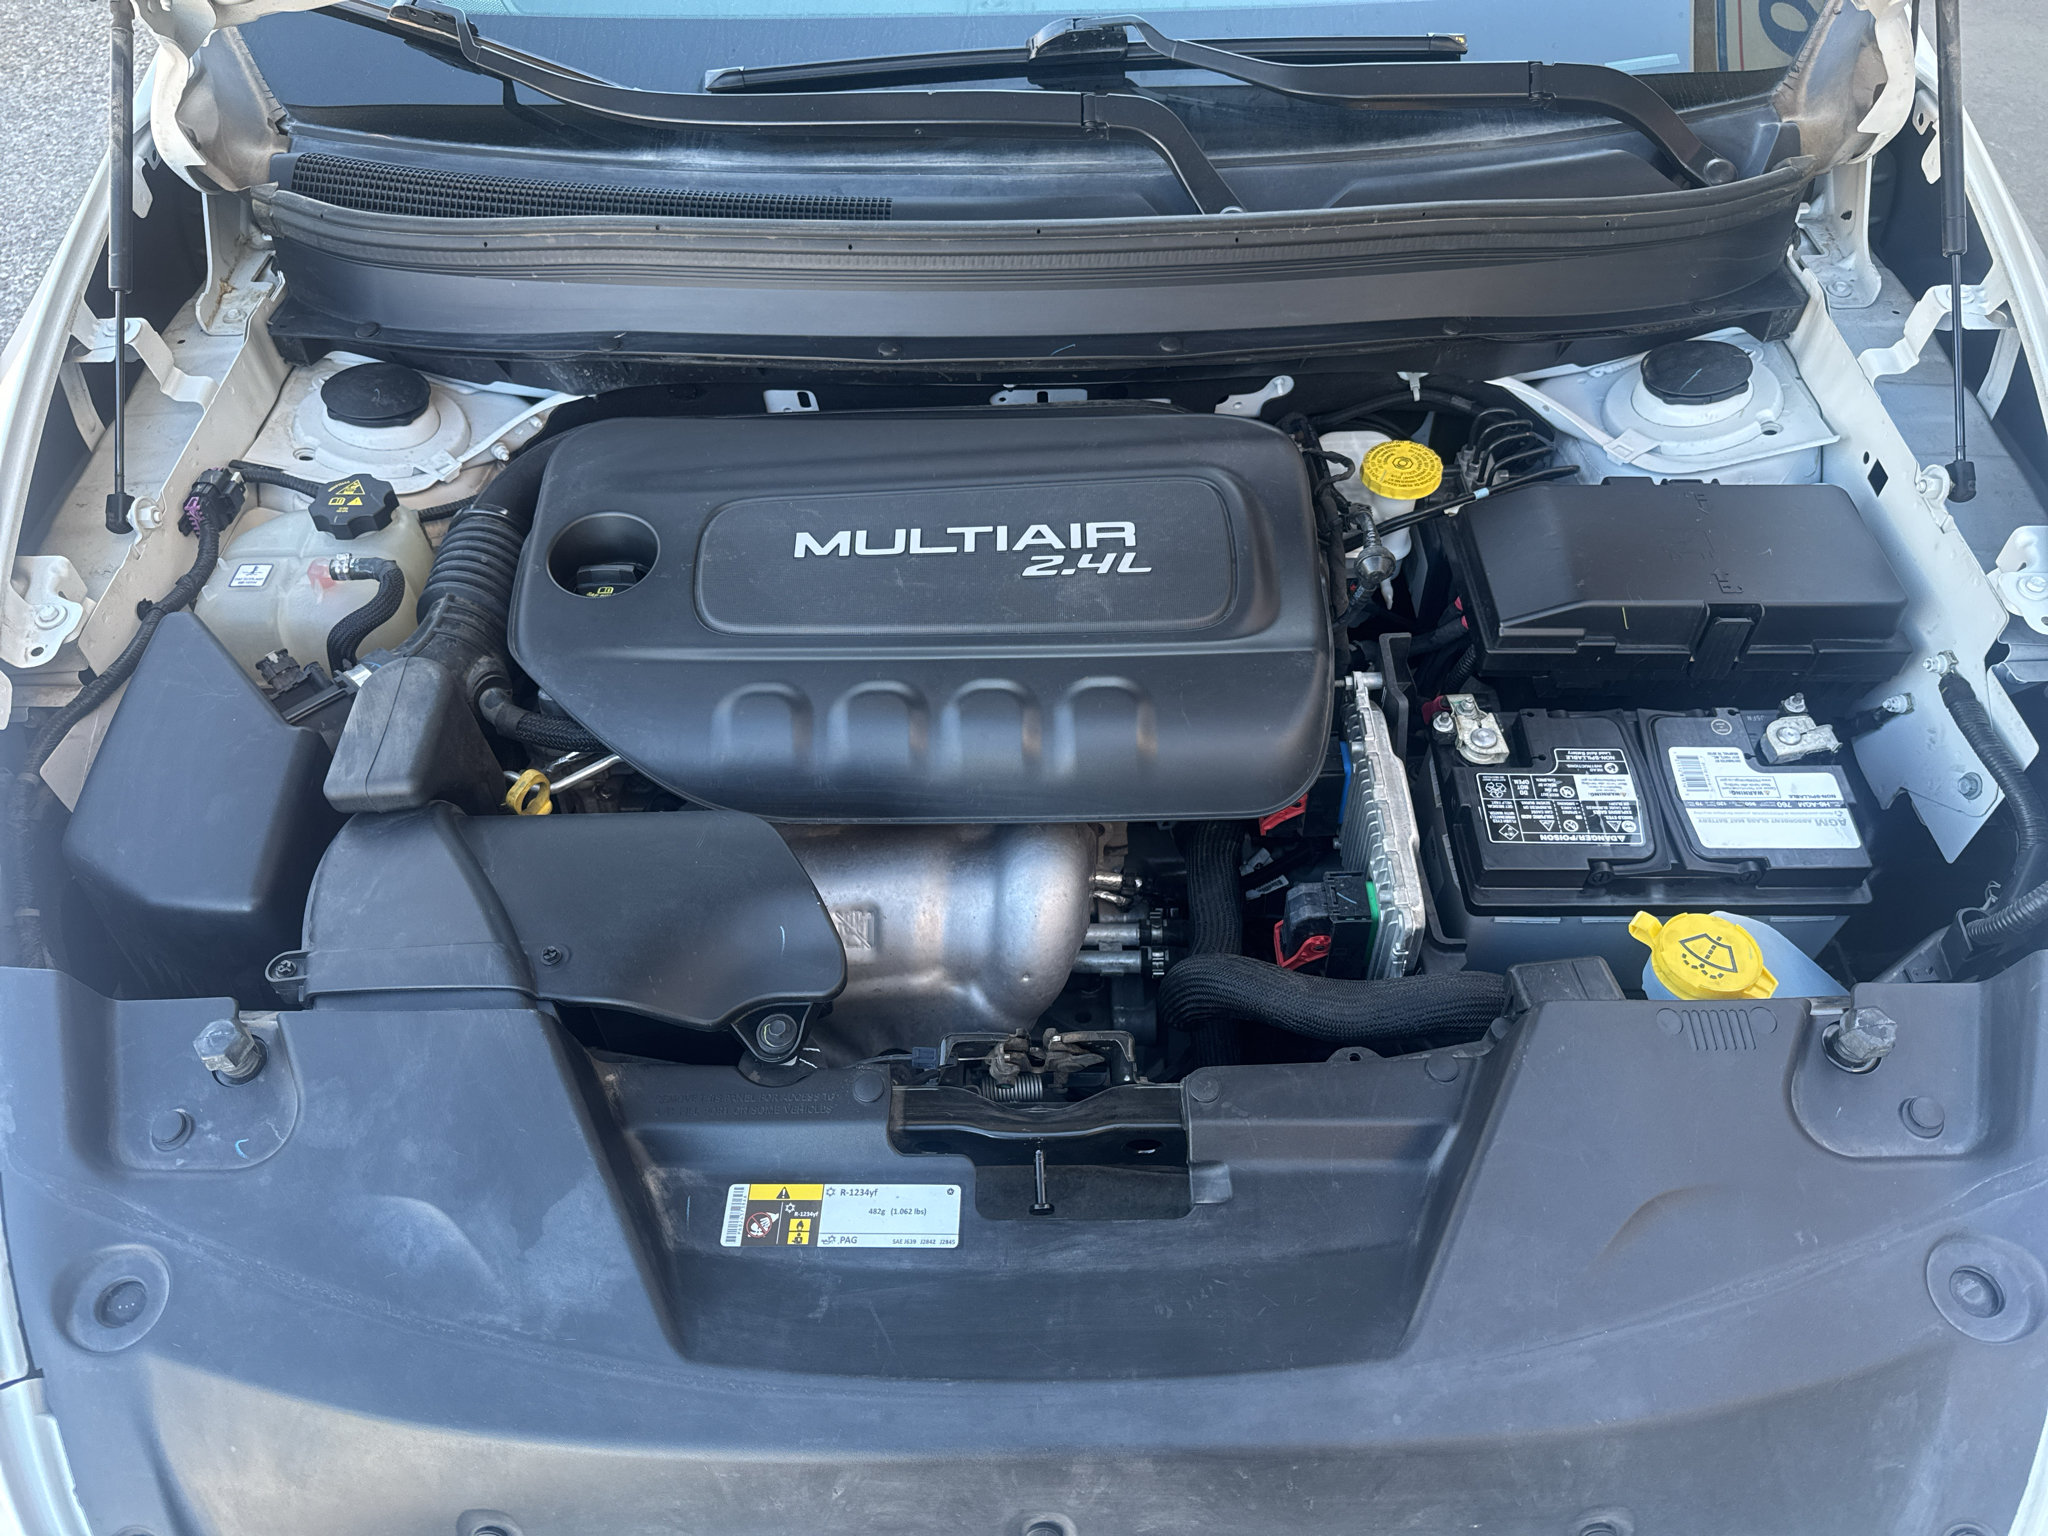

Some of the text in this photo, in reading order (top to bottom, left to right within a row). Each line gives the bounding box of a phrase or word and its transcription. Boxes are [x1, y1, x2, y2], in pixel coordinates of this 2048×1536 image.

[793, 521, 1137, 558] MULTIAIR
[1021, 552, 1153, 577] 2.4L
[1815, 818, 1847, 827] AGM
[840, 1189, 878, 1198] R-1234yf
[868, 1208, 927, 1216] 482g (1.062 lbs)
[840, 1236, 858, 1244] PAG
